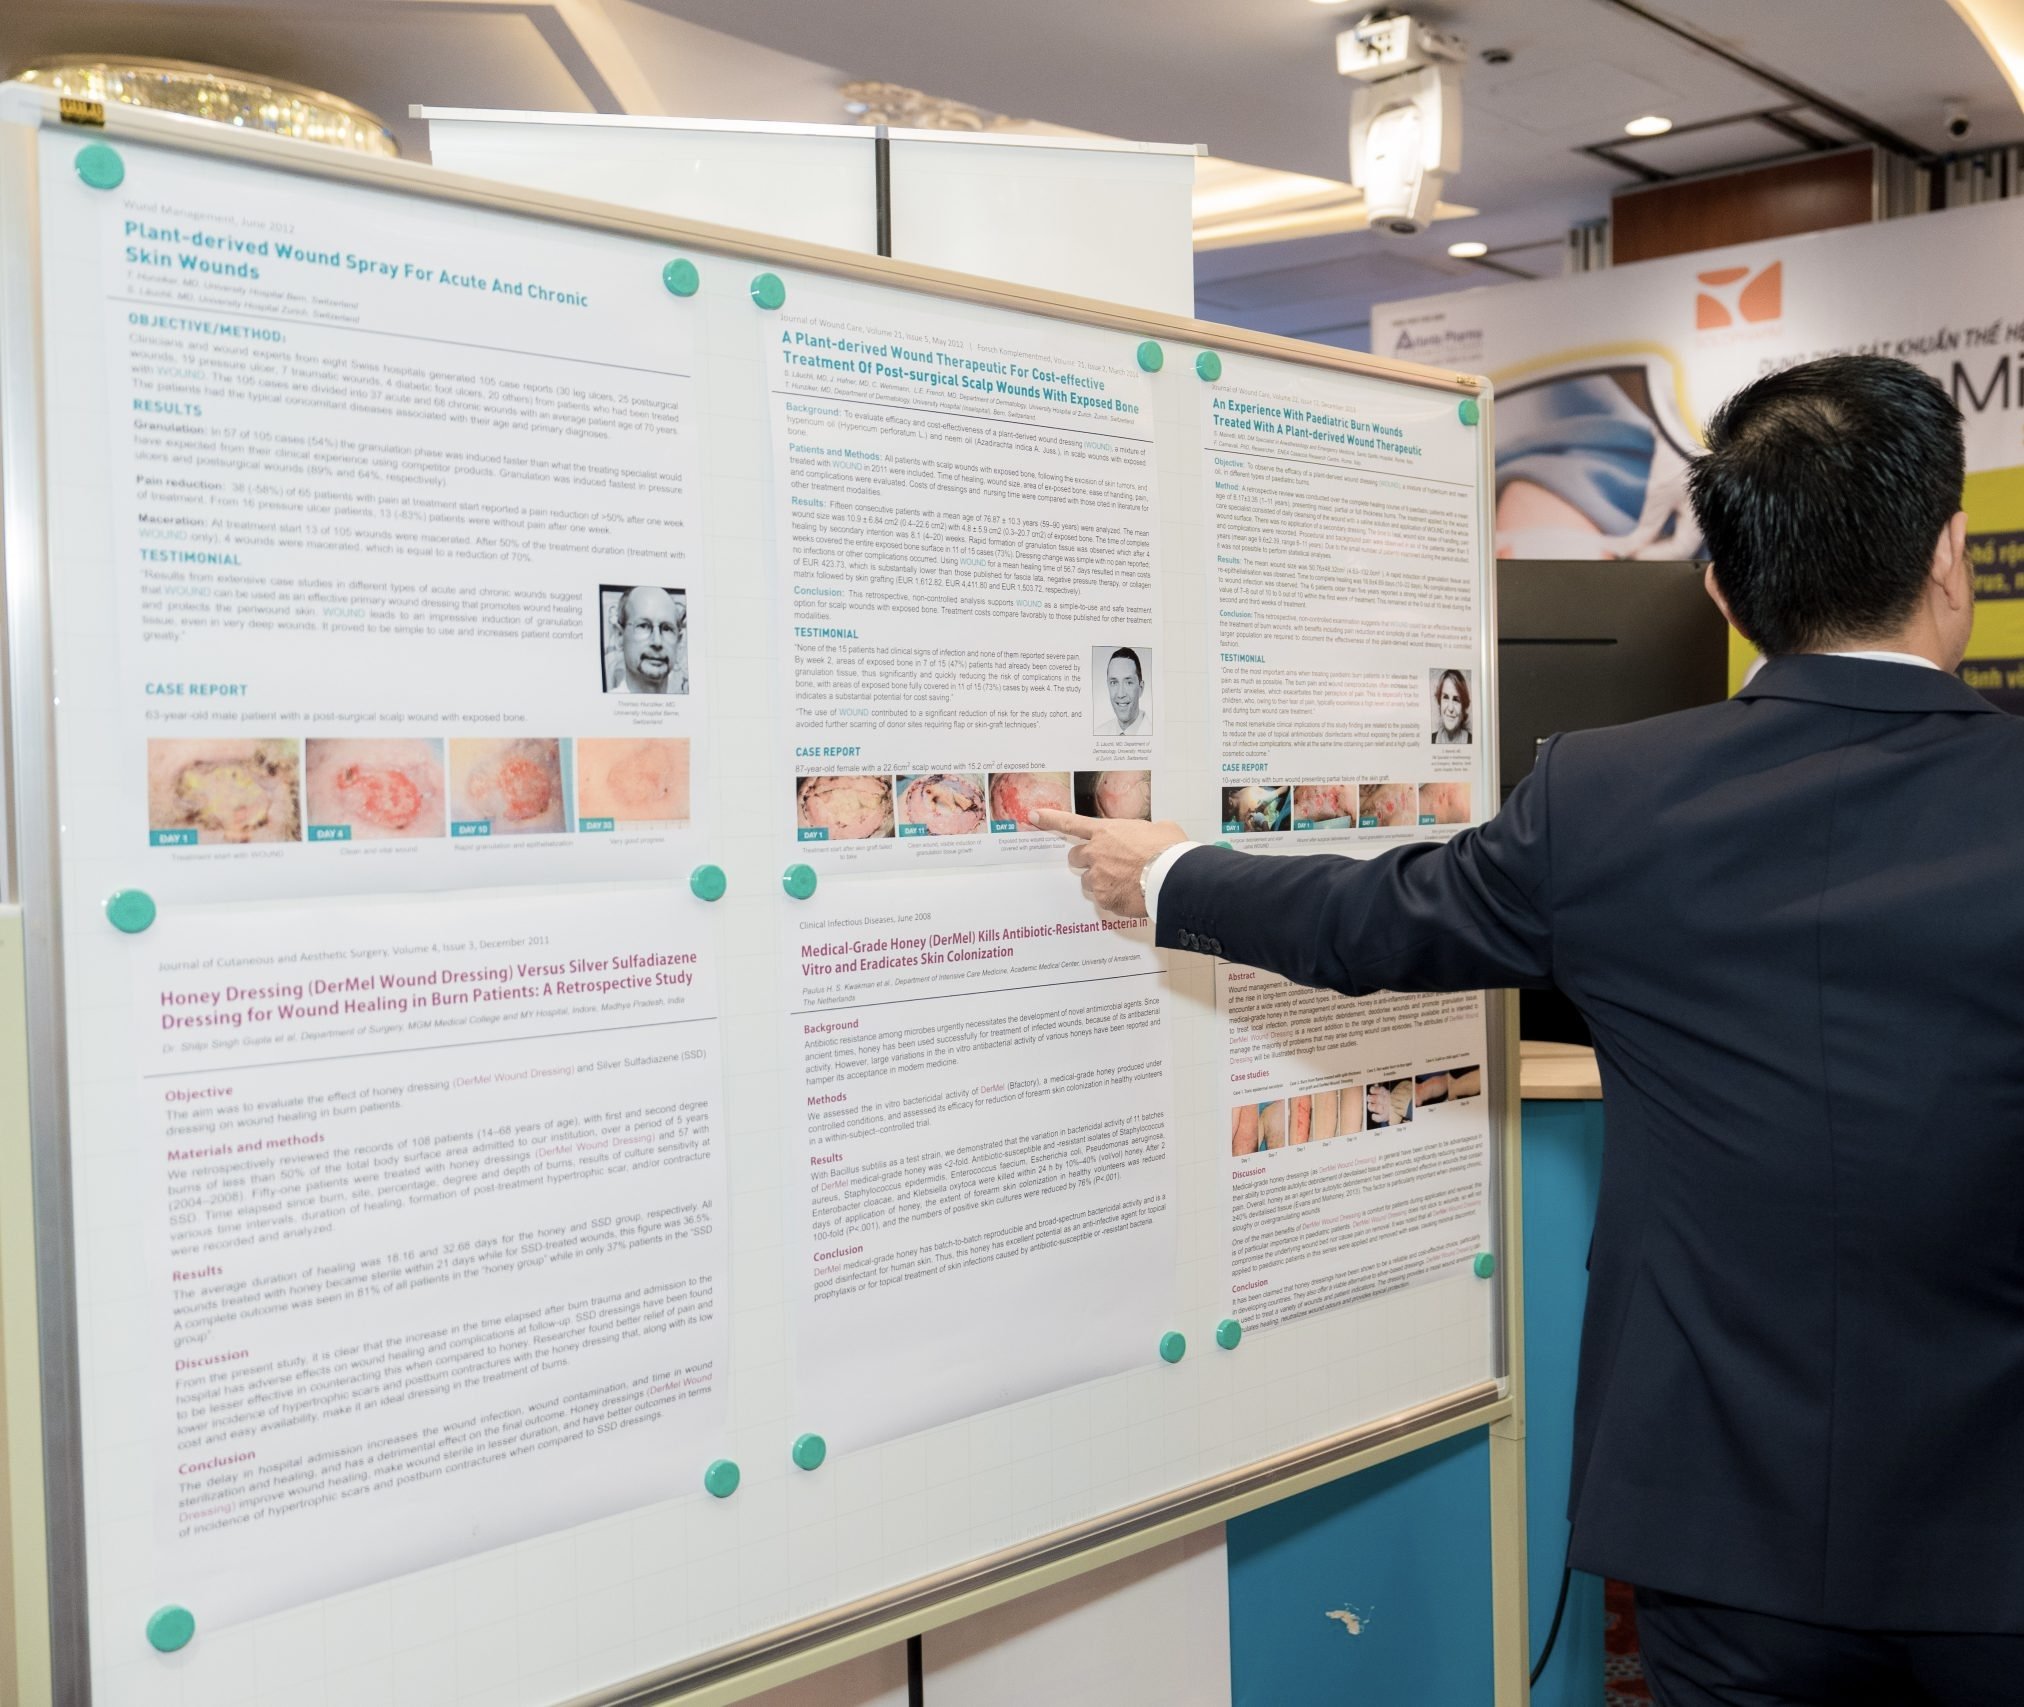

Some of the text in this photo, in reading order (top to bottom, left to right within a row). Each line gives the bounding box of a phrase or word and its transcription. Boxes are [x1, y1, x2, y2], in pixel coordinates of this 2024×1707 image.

[124, 220, 588, 307] Plant-derived Wound Spray For Acute And Chronic
[126, 246, 260, 280] Skin Wounds
[128, 312, 285, 342] OBJECTIVE/METHOD:
[782, 330, 1104, 390] A Plant-derived Wound Therapeutic For Cost-effective
[783, 350, 1139, 414] Treatment Of Post-surgical Scalp Wounds With Exposed Bone
[132, 398, 202, 416] RESULTS
[786, 401, 842, 416] Background:
[1213, 398, 1403, 437] An Experience With Paediatric Burn Wounds
[1213, 414, 1422, 456] Treated With A Plant-derived Wound Therapeutic
[789, 442, 881, 460] Patients and Methods:
[1214, 457, 1244, 467] Objective:
[1215, 481, 1239, 490] Method:
[791, 496, 826, 507] Results:
[141, 549, 239, 565] TESTIMONIAL
[1217, 555, 1241, 564] Results:
[793, 585, 844, 596] Conclusion:
[1219, 609, 1253, 618] Conclusion:
[794, 627, 858, 639] TESTIMONIAL
[1220, 653, 1265, 663] TESTIMONIAL
[145, 683, 246, 696] CASE REPORT
[796, 746, 860, 756] CASE REPORT
[1222, 763, 1268, 771] CASE REPORT
[799, 920, 826, 929] Clinical
[828, 919, 863, 927] Infectious
[914, 912, 931, 920] 2008
[801, 916, 1149, 957] Medical-Grade Honey (DerMel) Kills Antibiotic-Resistant Bacteria In
[158, 936, 549, 972] Journal of Cutaneous and Aesthetic Surgery, Volume 4, Issue 3, December 2011
[802, 946, 1013, 976] Vitro and Eradicates Skin Colonization
[160, 953, 697, 1006] Honey Dressing (DerMel Wound Dressing) Versus Silver Sulfadiazene
[1228, 972, 1255, 981] Abstract
[162, 970, 692, 1029] Dressing for Wound Healing in Burn Patients: A Retrospective Study
[804, 1018, 859, 1034] Background
[1230, 1069, 1269, 1082] Case studies
[165, 1087, 233, 1102] Objective
[807, 1092, 847, 1106] Methods
[167, 1132, 325, 1161] Materials and methods
[810, 1153, 843, 1165] Results
[1232, 1167, 1266, 1179] Discussion
[813, 1245, 863, 1261] Conclusion
[172, 1266, 223, 1281] Results
[1232, 1279, 1268, 1293] Conclusion
[175, 1349, 249, 1371] Discussion
[178, 1451, 256, 1475] Conclusion
